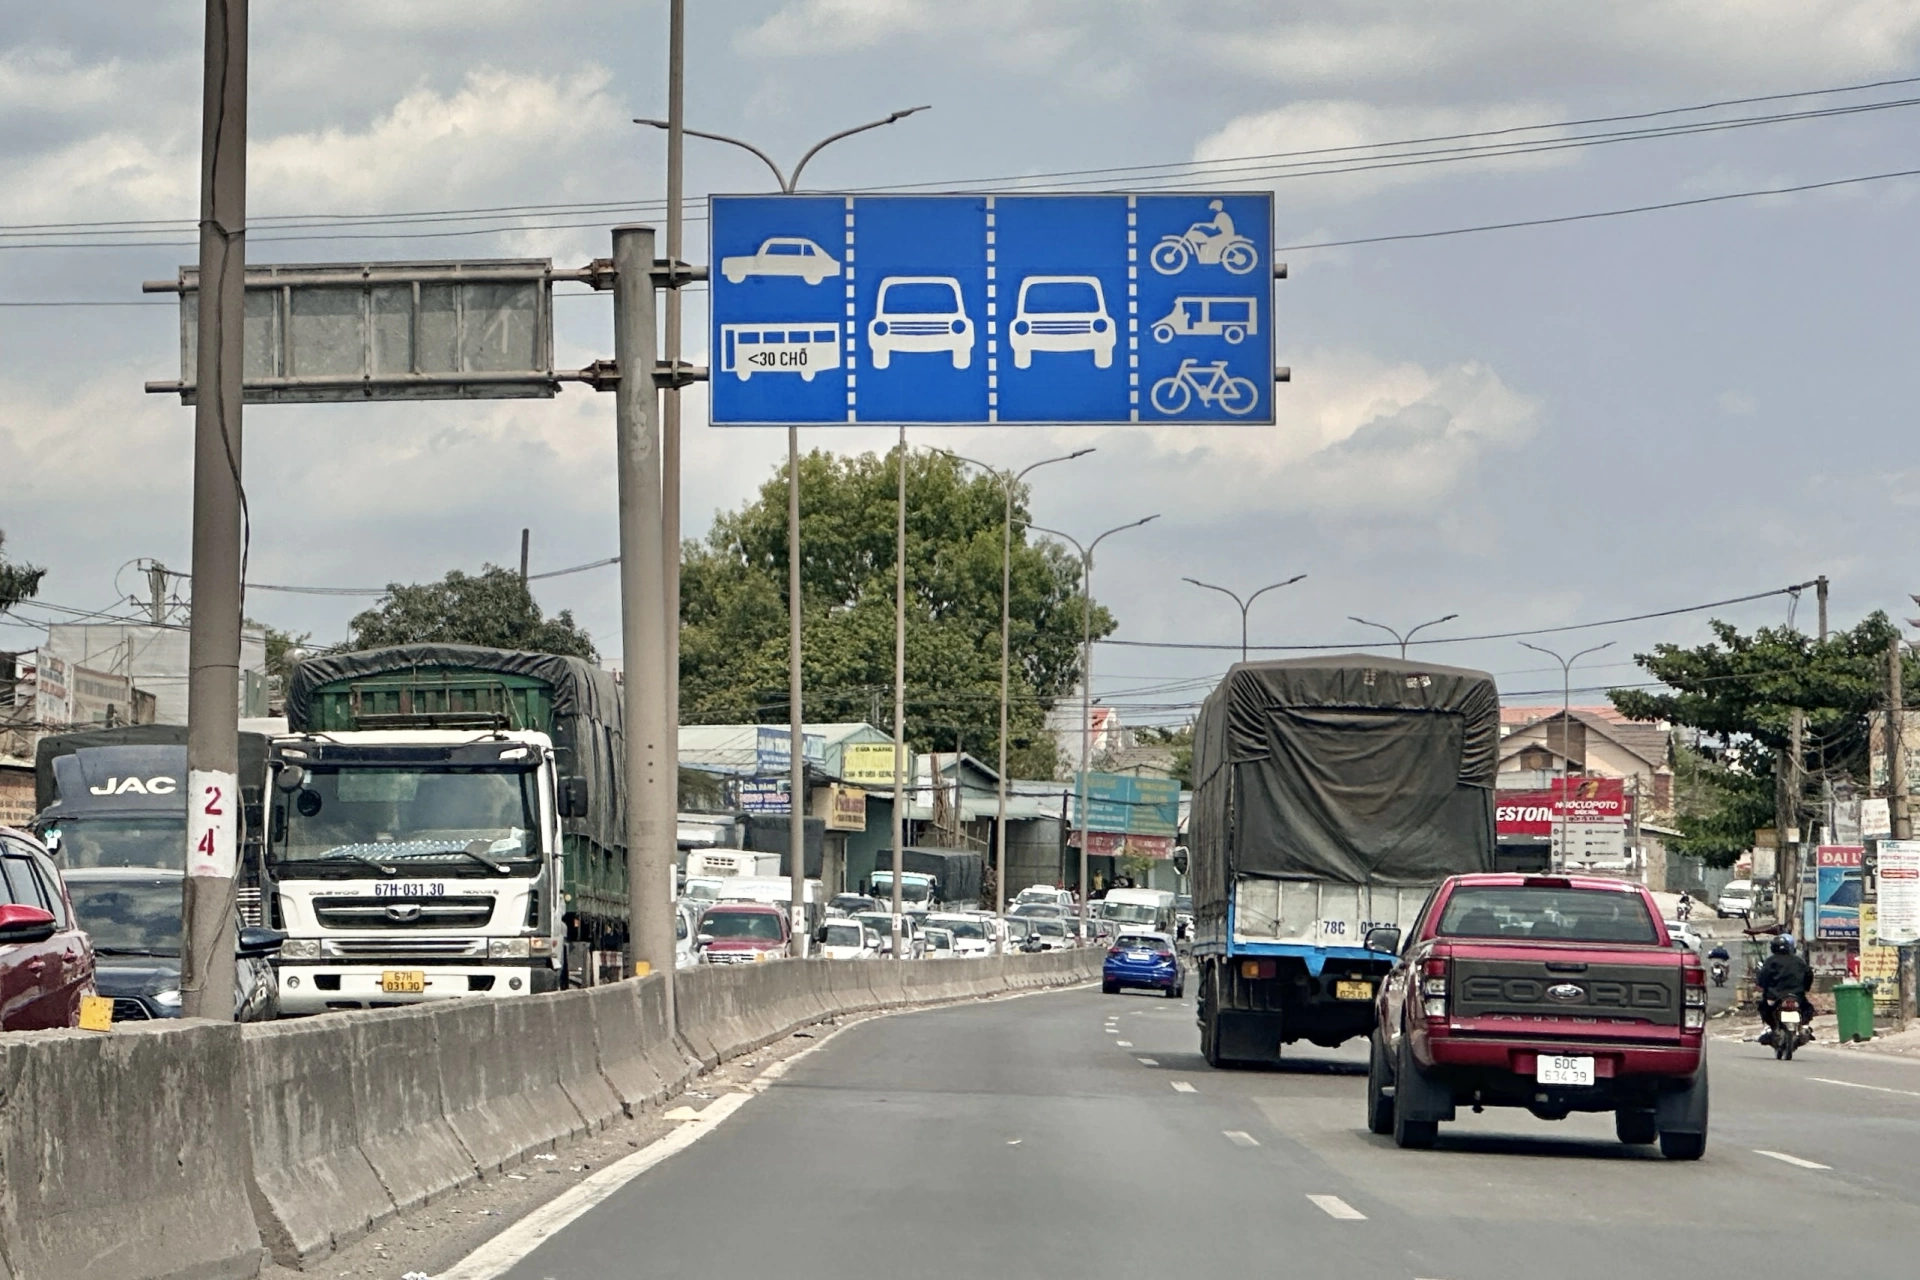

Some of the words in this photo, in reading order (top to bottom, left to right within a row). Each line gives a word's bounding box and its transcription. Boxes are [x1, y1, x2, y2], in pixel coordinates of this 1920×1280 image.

[748, 351, 776, 366] <30
[780, 347, 808, 366] CHỖ
[90, 776, 176, 795] JAC
[205, 786, 222, 815] 2
[198, 828, 214, 856] 4
[1823, 853, 1847, 867] ĐẠI
[375, 883, 445, 896] 67H-031.30
[1323, 921, 1346, 934] 78C
[394, 972, 413, 981] 67H
[1462, 977, 1671, 1007] FORD
[1554, 1057, 1578, 1069] 60C
